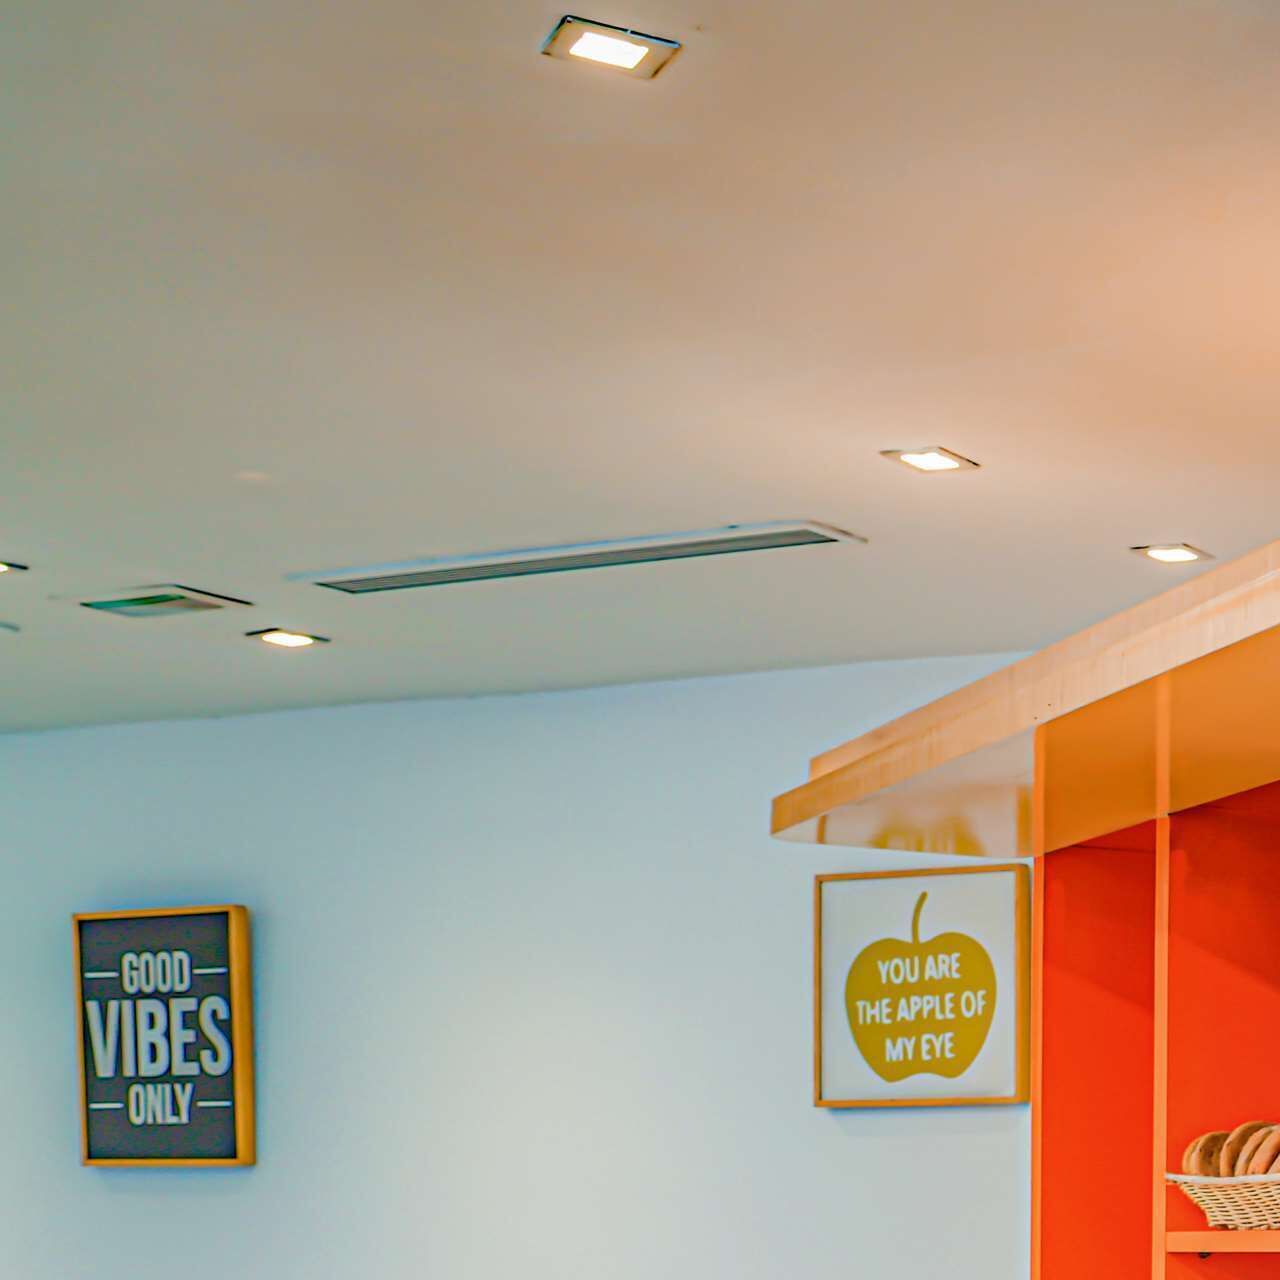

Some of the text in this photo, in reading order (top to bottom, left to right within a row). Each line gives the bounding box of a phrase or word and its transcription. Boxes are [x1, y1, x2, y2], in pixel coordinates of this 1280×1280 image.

[121, 950, 192, 994] GOOD
[877, 952, 961, 985] YOU ARE
[855, 989, 987, 1025] THE APPLE OF
[85, 995, 232, 1078] VIBES
[884, 1032, 956, 1062] MY EYE
[127, 1082, 194, 1125] ONLY
